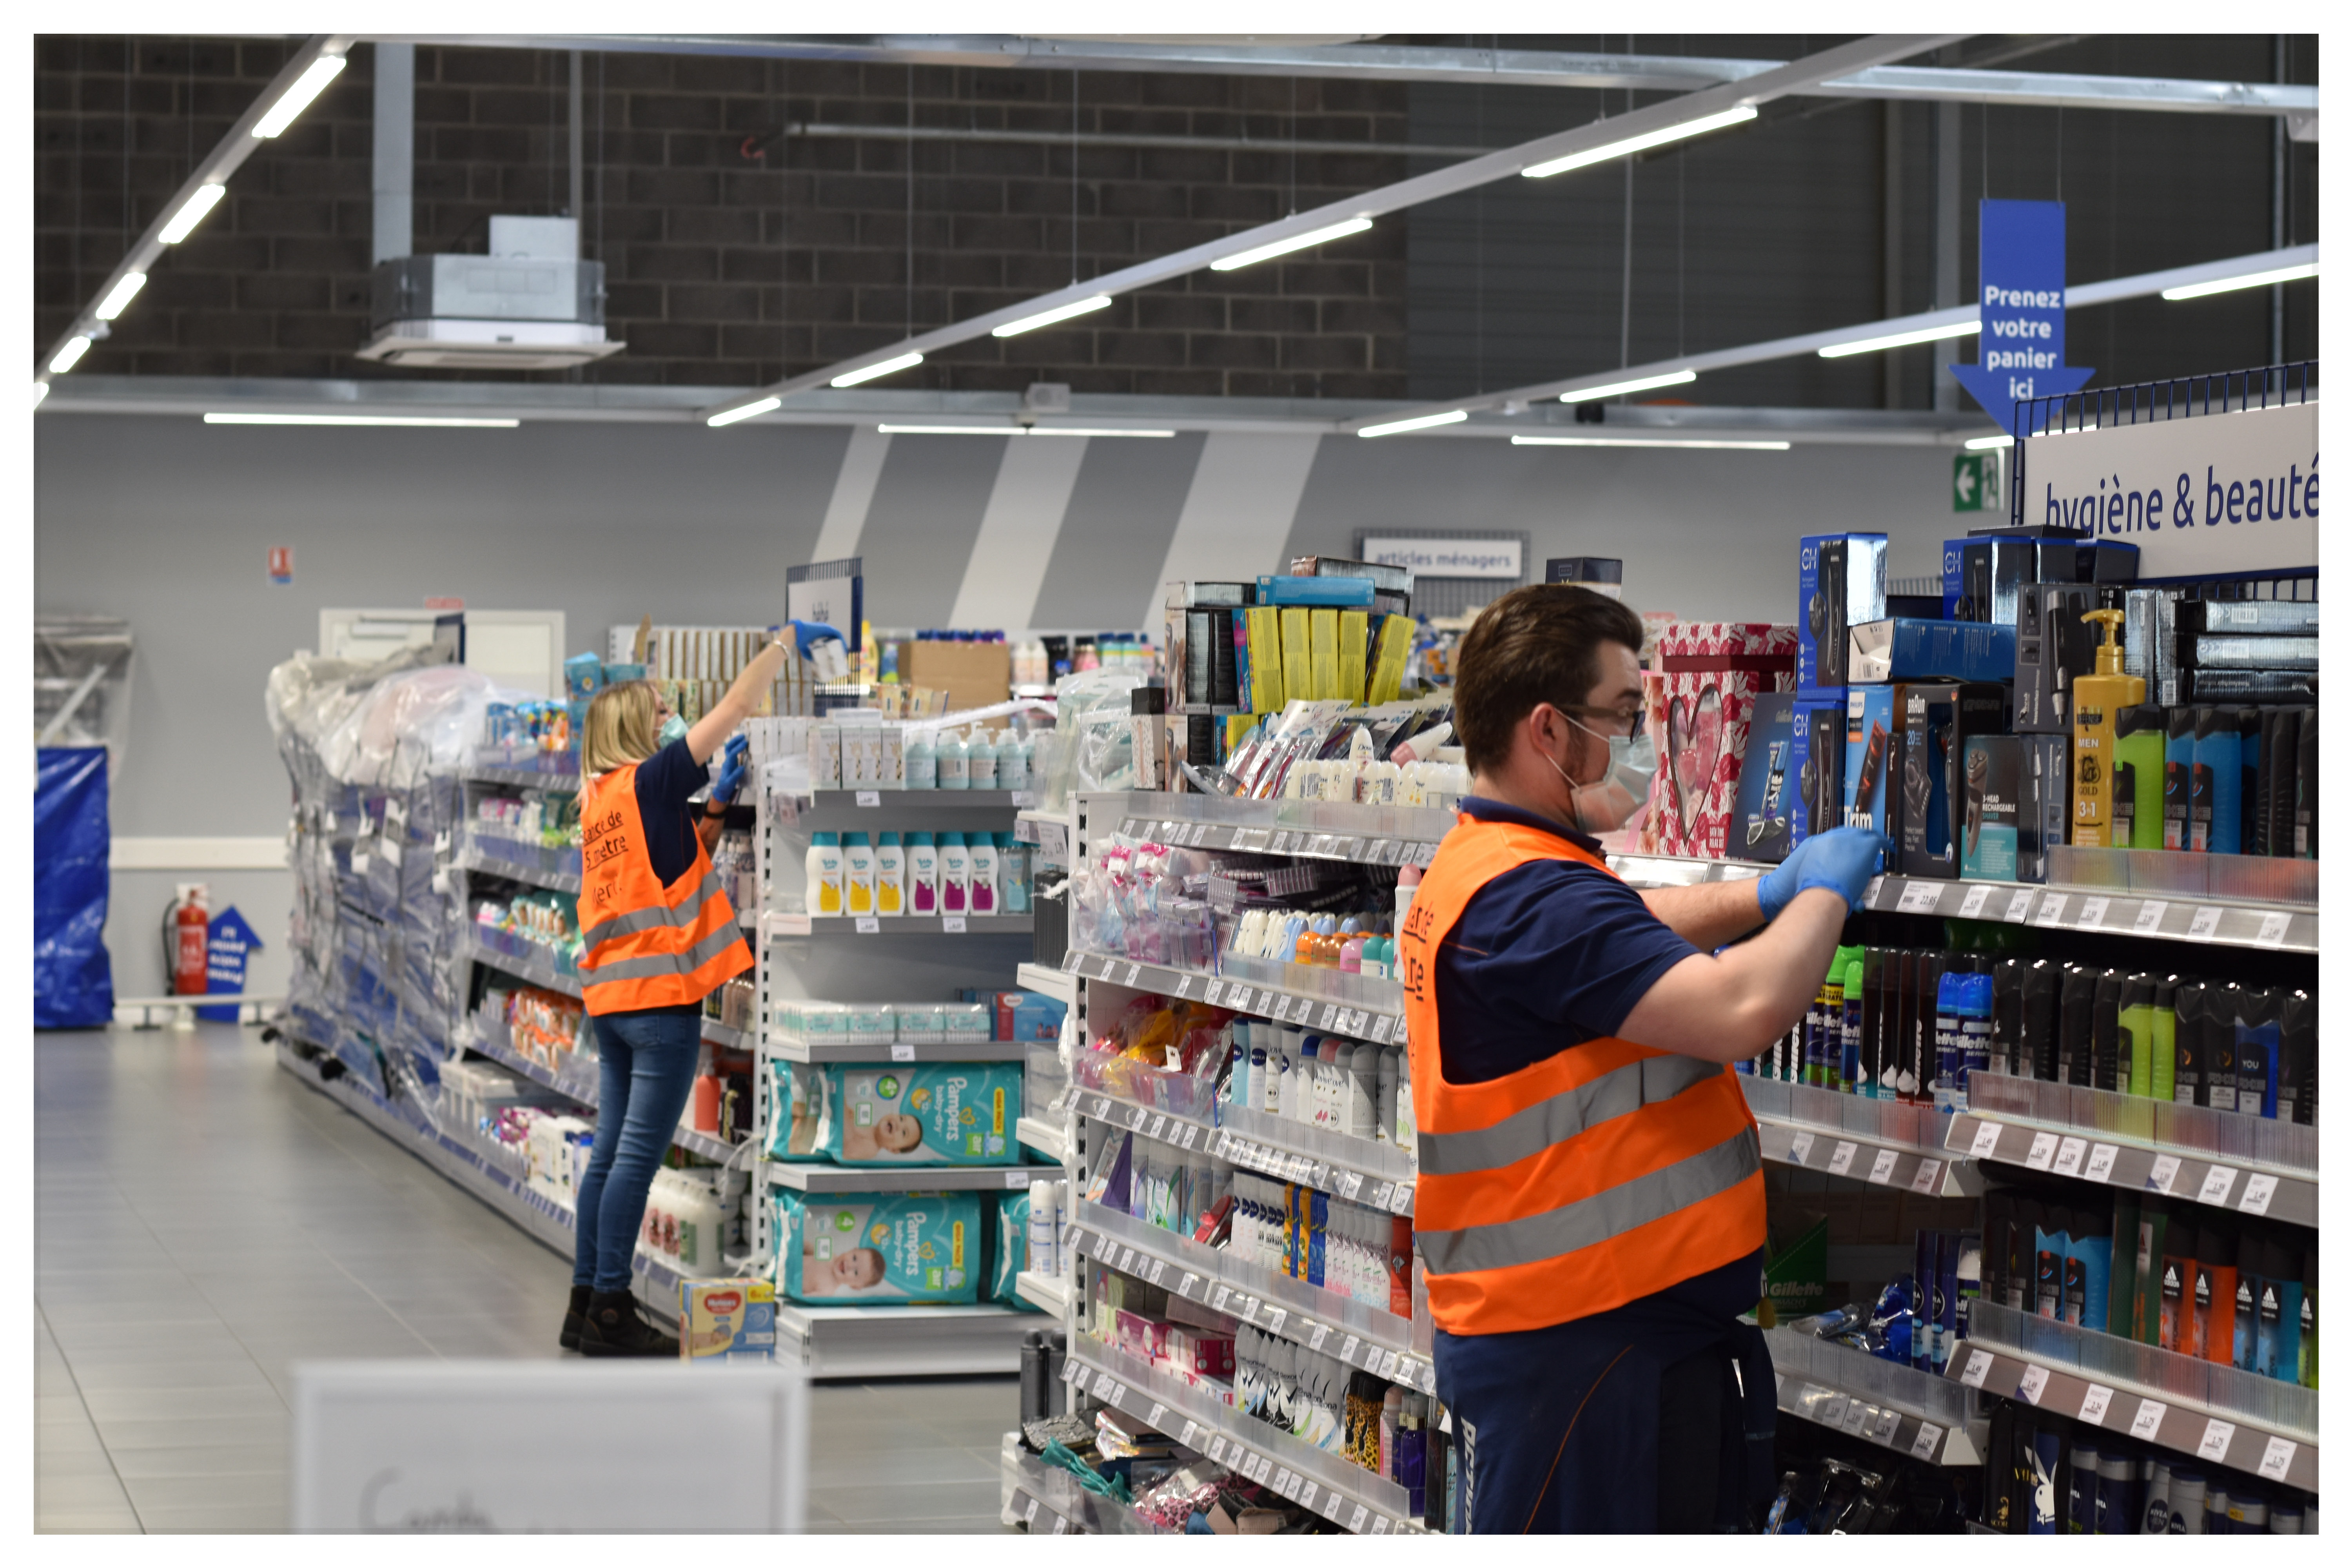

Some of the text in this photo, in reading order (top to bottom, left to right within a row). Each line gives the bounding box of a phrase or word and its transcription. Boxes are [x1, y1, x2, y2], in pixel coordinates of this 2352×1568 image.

[1985, 285, 2060, 308] Prenez
[1992, 318, 2051, 339] votre
[1987, 347, 2057, 372] panier
[2009, 377, 2033, 399] ici
[2172, 473, 2195, 529] &
[2206, 451, 2318, 526] beauté
[1376, 550, 1512, 570] articles ménagers
[1908, 693, 1925, 714] BRAUN
[1907, 730, 1915, 746] 20
[2078, 738, 2099, 748] MEN
[1357, 744, 1372, 752] Dove
[1982, 795, 1999, 803] 3-HEAD
[2078, 786, 2098, 796] GOLD
[1982, 803, 2016, 812] RECHARGEABLE
[1982, 812, 1999, 820] SHAVER
[608, 810, 622, 826] de
[1844, 805, 1873, 829] Trim
[1920, 895, 1938, 907] 22.95
[2242, 1060, 2259, 1069] YOU
[933, 1085, 944, 1133] baby-dry
[946, 1076, 967, 1141] Pampers
[893, 1220, 904, 1269] baby-dry
[906, 1211, 927, 1276] Pampers
[1769, 1280, 1824, 1298] Gillette
[2262, 1300, 2278, 1310] adidas
[2150, 1508, 2167, 1519] NIVEA
[2171, 1523, 2187, 1533] NIVEA
